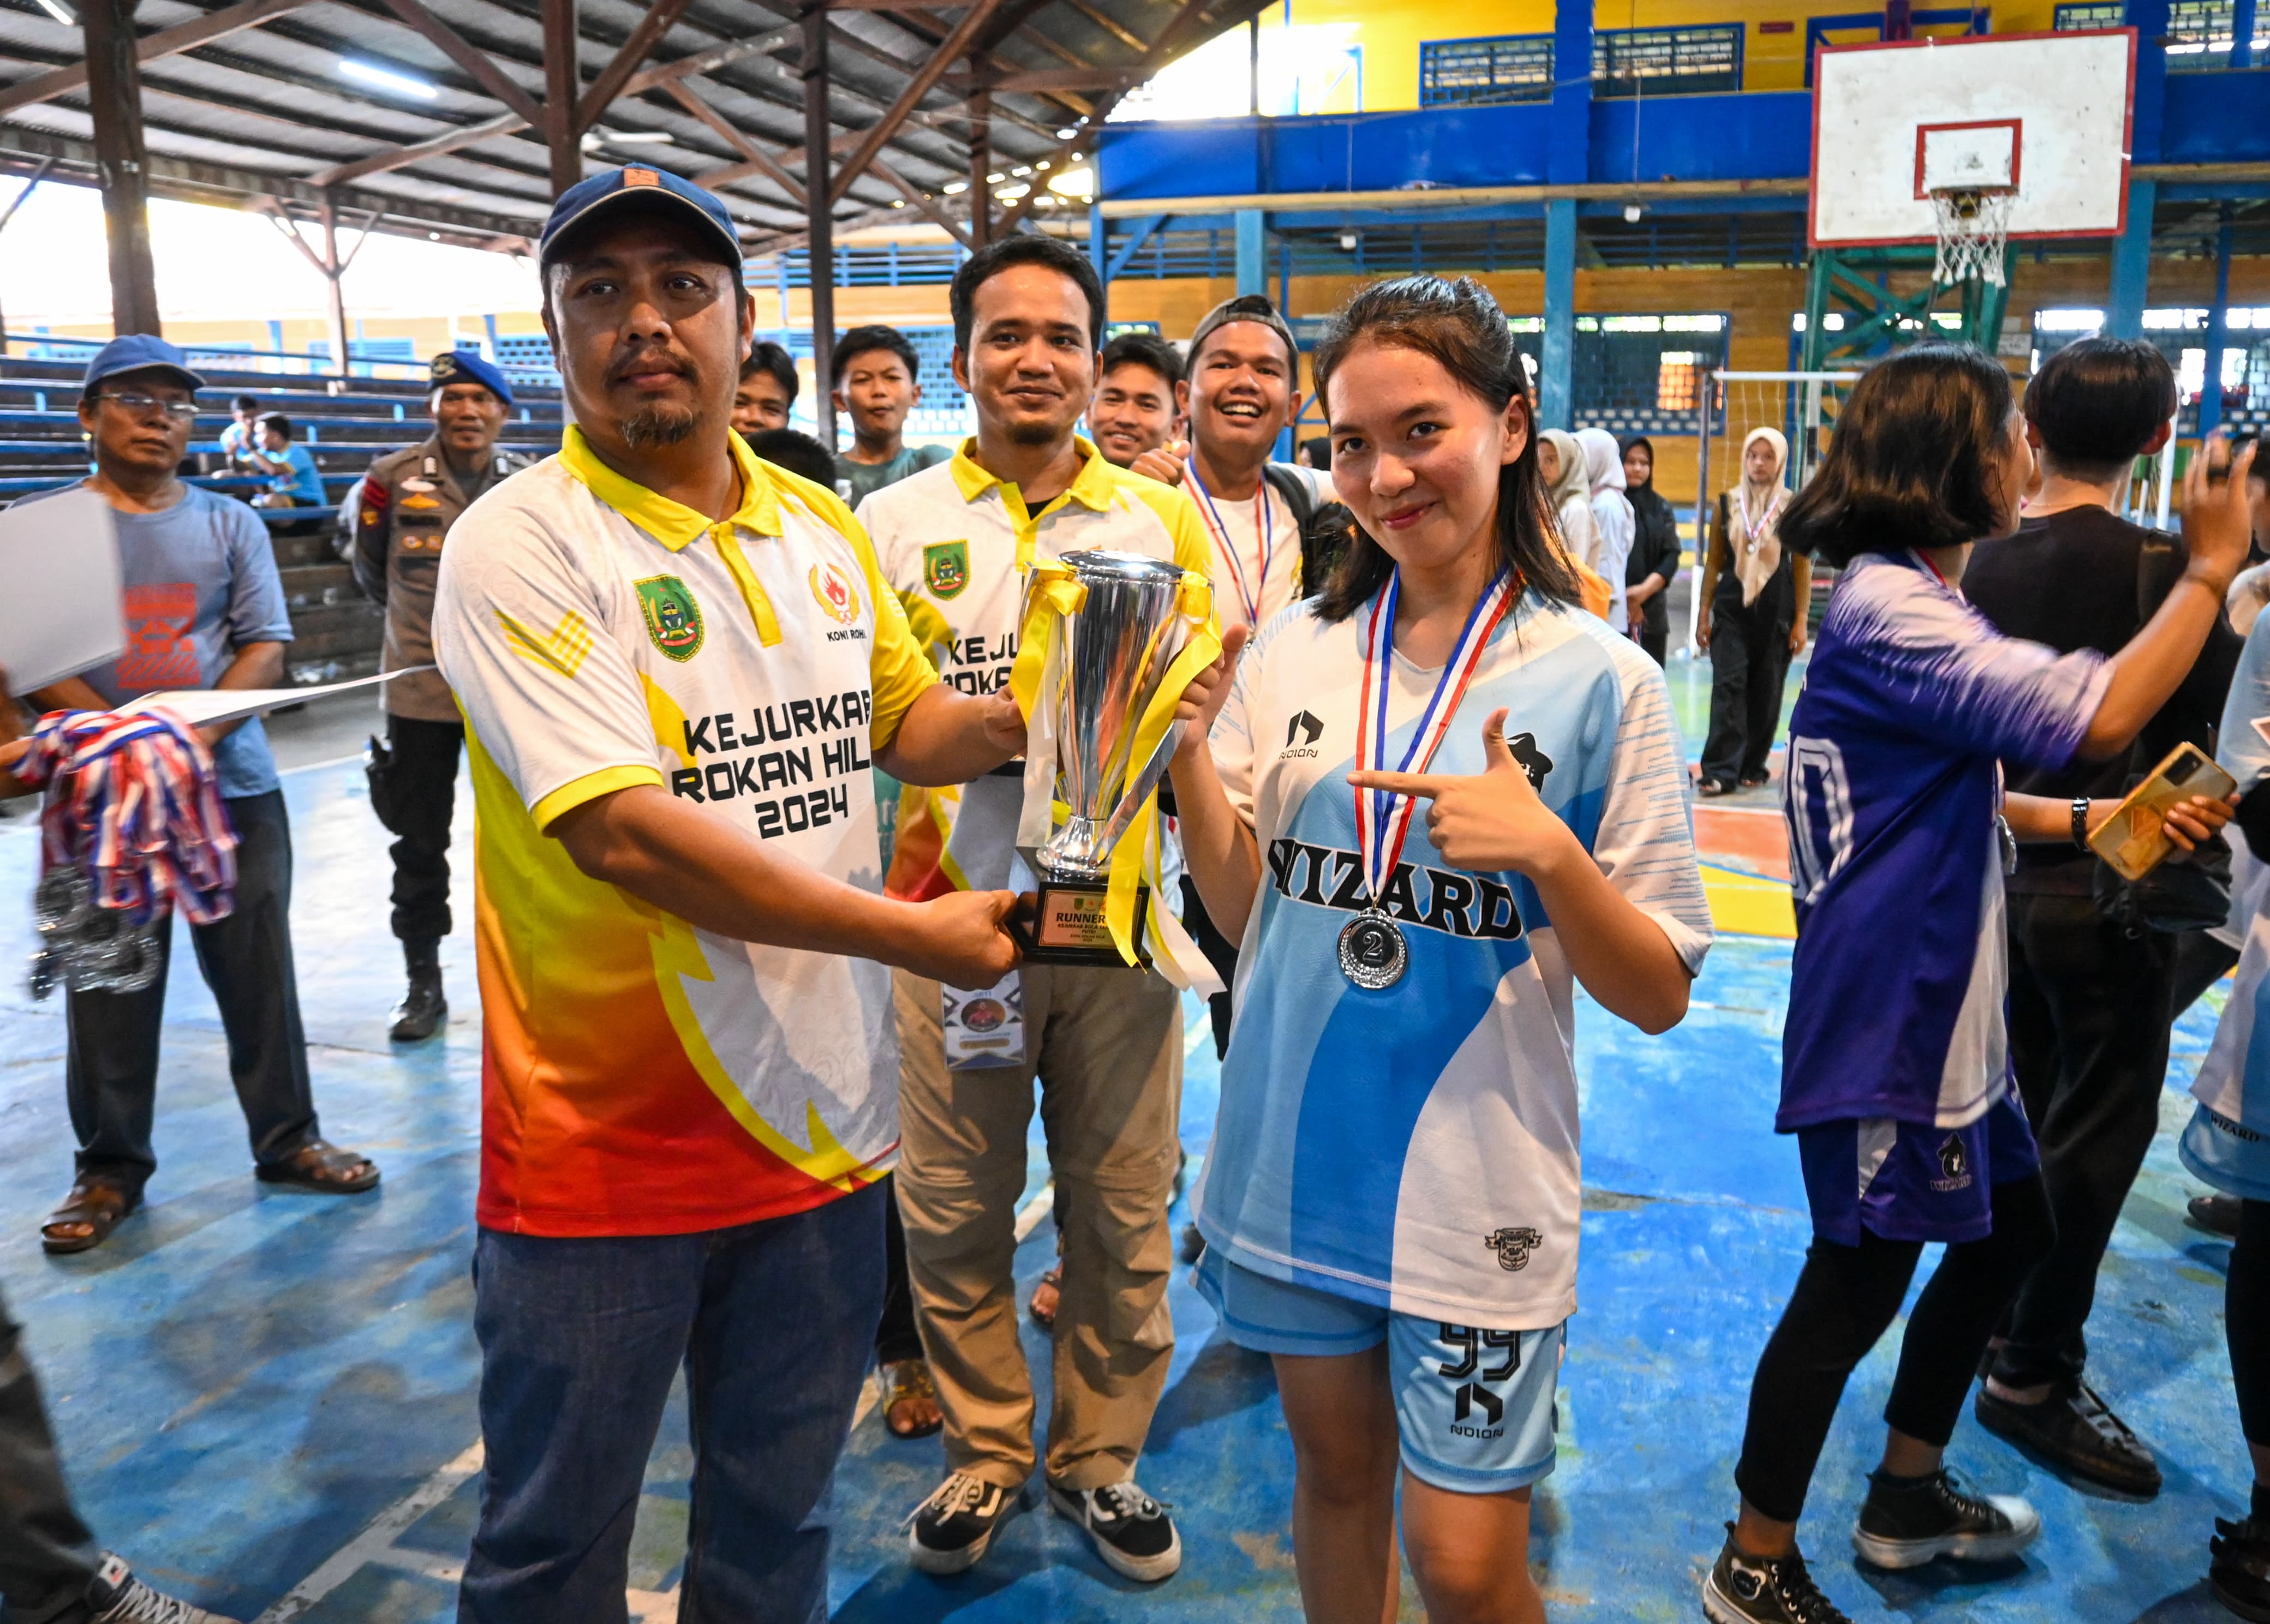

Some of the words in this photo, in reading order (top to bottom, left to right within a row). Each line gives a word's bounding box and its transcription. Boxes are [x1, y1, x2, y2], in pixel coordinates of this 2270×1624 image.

[827, 630, 849, 642] KONI
[671, 747, 813, 804] ROKAN
[754, 784, 849, 840] 2024
[1056, 913, 1106, 924] RUNNER
[1363, 931, 1383, 963] 2
